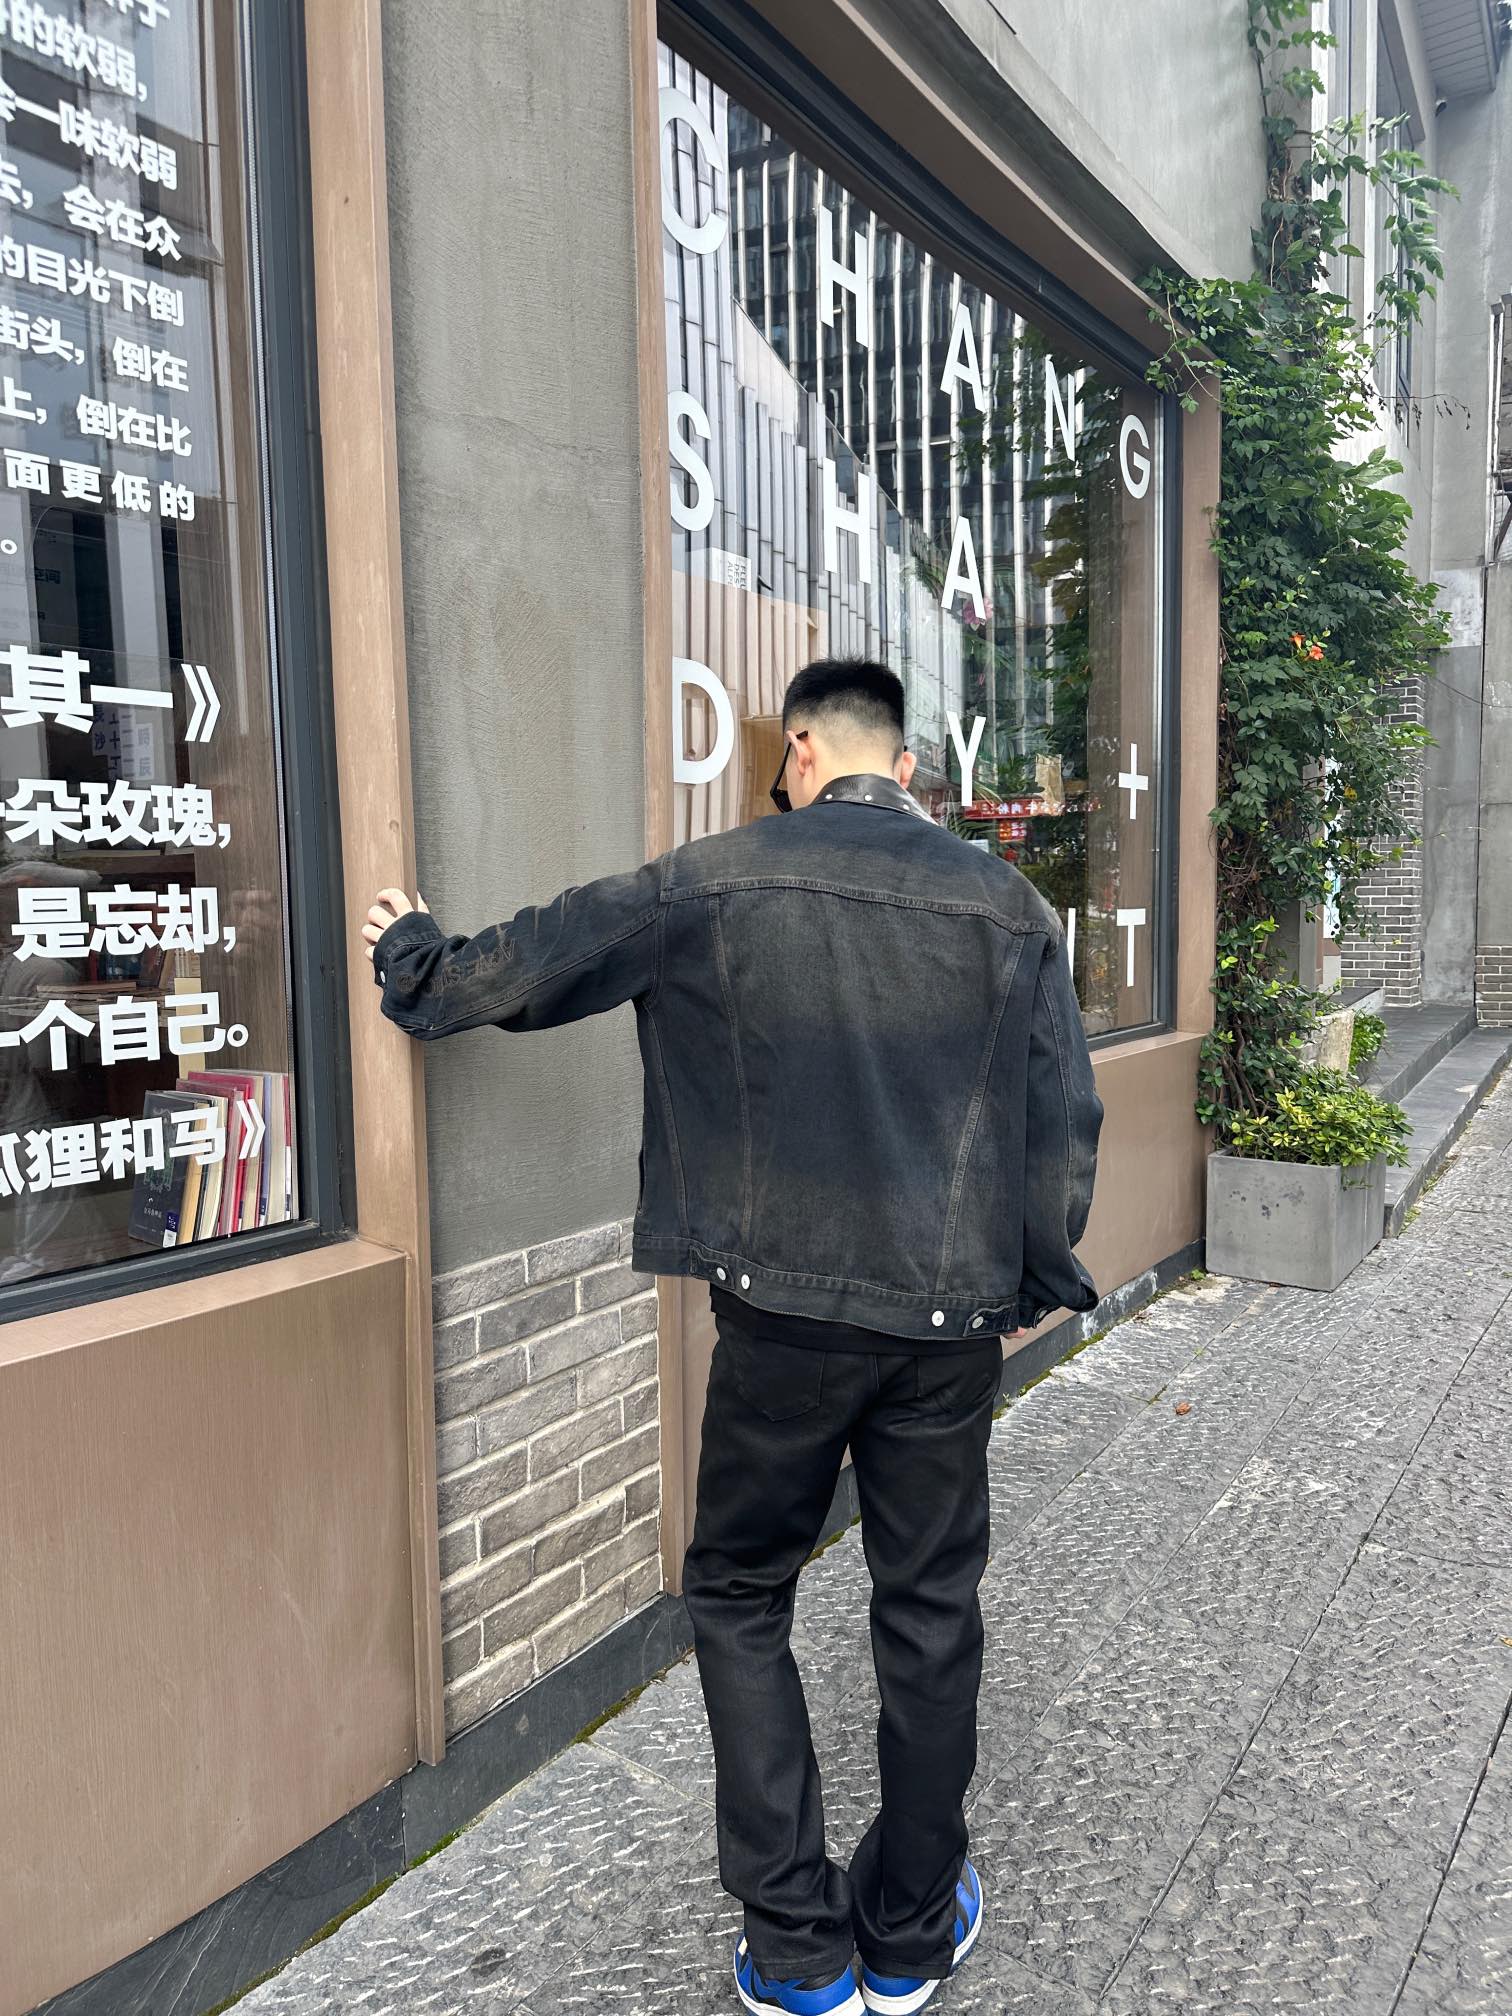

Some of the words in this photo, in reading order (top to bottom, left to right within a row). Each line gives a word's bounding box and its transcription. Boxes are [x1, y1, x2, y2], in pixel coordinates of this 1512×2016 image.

[0, 0, 148, 102] 的软弱，
[659, 86, 1151, 500] CHANG
[666, 390, 987, 621] SHA
[0, 778, 231, 849] 朵玫瑰，
[11, 883, 236, 961] 是忘却，
